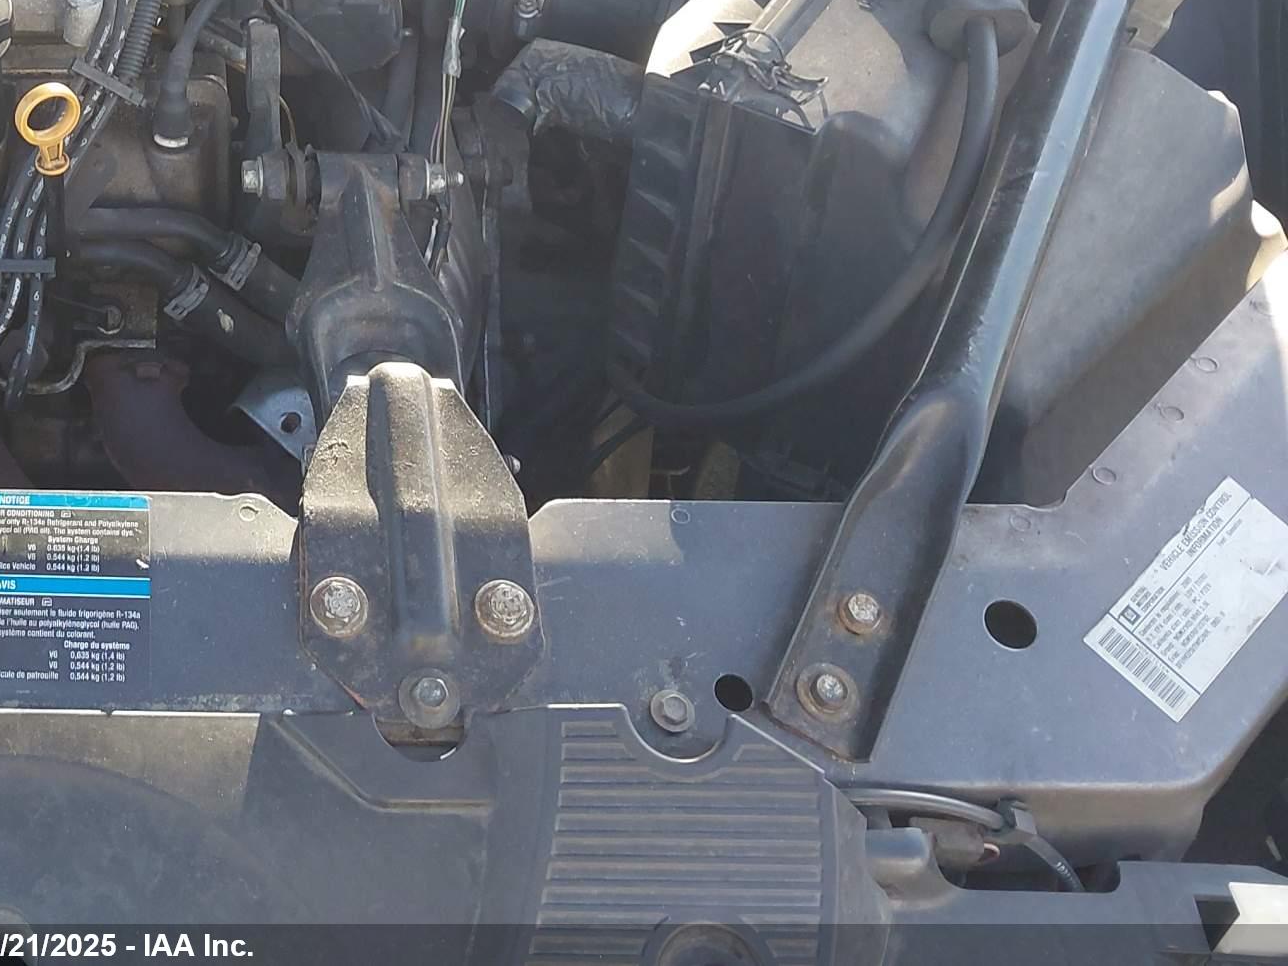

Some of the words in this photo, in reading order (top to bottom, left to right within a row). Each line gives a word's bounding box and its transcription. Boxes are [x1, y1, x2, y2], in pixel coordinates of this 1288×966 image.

[0, 496, 30, 504] NOTICE
[7, 519, 20, 527] only
[47, 519, 83, 528] Refrigerant
[48, 536, 73, 544] System
[1186, 517, 1223, 557] INFORMATION
[1160, 544, 1185, 570] VEHICLE
[1181, 518, 1208, 548] EMISSION
[67, 545, 76, 553] kg
[67, 554, 76, 562] kg
[12, 562, 36, 571] Vehicle
[67, 563, 76, 572] kg
[14, 609, 48, 617] seulement
[78, 611, 113, 619] frigorigène
[116, 611, 141, 619] R-134a
[101, 620, 120, 629] (huile
[27, 630, 54, 638] contient
[56, 630, 64, 638] du
[66, 631, 95, 639] colorant.
[64, 641, 89, 649] Charge
[101, 642, 130, 651] système
[91, 651, 100, 661] kg
[91, 662, 100, 671] kg
[17, 670, 25, 678] de
[27, 671, 58, 680] patrouille
[91, 673, 99, 682] kg
[116, 673, 125, 682] lb)
